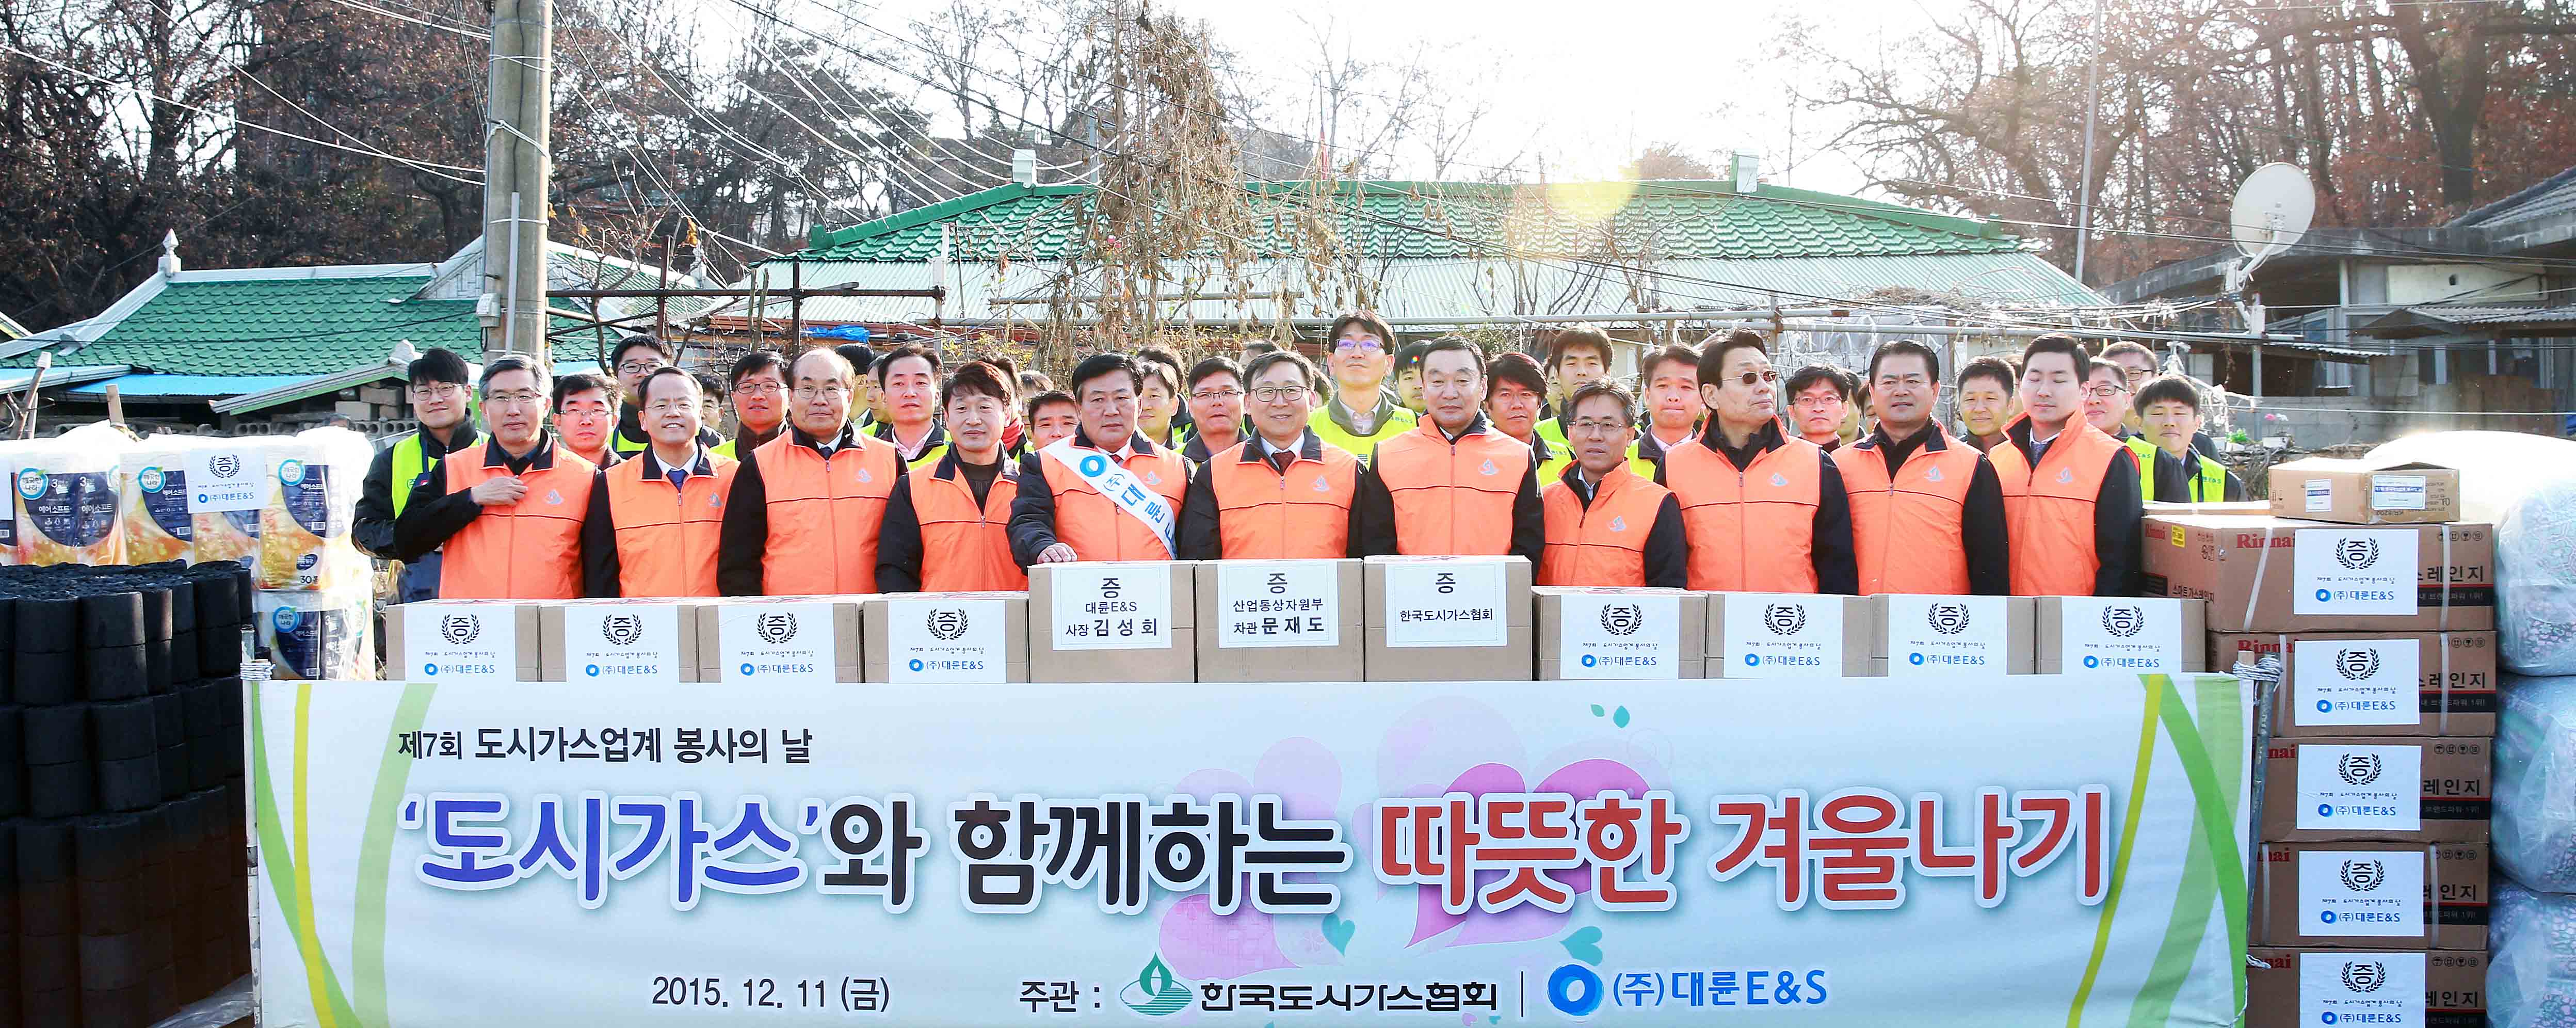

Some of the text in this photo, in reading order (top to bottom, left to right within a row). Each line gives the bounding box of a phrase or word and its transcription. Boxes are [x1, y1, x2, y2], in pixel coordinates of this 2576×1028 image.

[217, 457, 233, 478] 증
[2346, 541, 2370, 561] 증
[1100, 577, 1121, 599] 증
[1267, 573, 1288, 594] 증
[1435, 572, 1456, 594] 증
[1085, 601, 1137, 615] 대륜E&S
[1233, 598, 1324, 613] 산업통상자원부
[1399, 608, 1493, 622] 한국도시가스협회
[449, 617, 471, 637] 증
[611, 617, 632, 637] 증
[766, 616, 787, 636] 증
[937, 612, 958, 632] 증
[1610, 607, 1632, 627] 증
[1773, 607, 1796, 628] 증
[1937, 606, 1960, 628] 증
[2111, 608, 2133, 630] 증
[1065, 623, 1089, 637] 사장
[1234, 621, 1258, 635] 차관
[2346, 651, 2370, 673] 증
[396, 726, 813, 764] 제7회 도시가스업계 봉사의 날
[2348, 757, 2371, 778] 증
[2423, 778, 2481, 795] 레인지
[954, 800, 1346, 907] 함께하는
[1381, 798, 1683, 907] 따뜻한
[1715, 792, 2102, 903] 겨울나기
[2350, 863, 2374, 885] 증
[2352, 965, 2375, 986] 증
[652, 976, 889, 1013] 2015. 12. 11 (금)
[1019, 981, 1080, 1013] 주관
[1200, 982, 1496, 1012] 한국도시가스협회
[1613, 969, 1828, 1007] (주)대륜E&S
